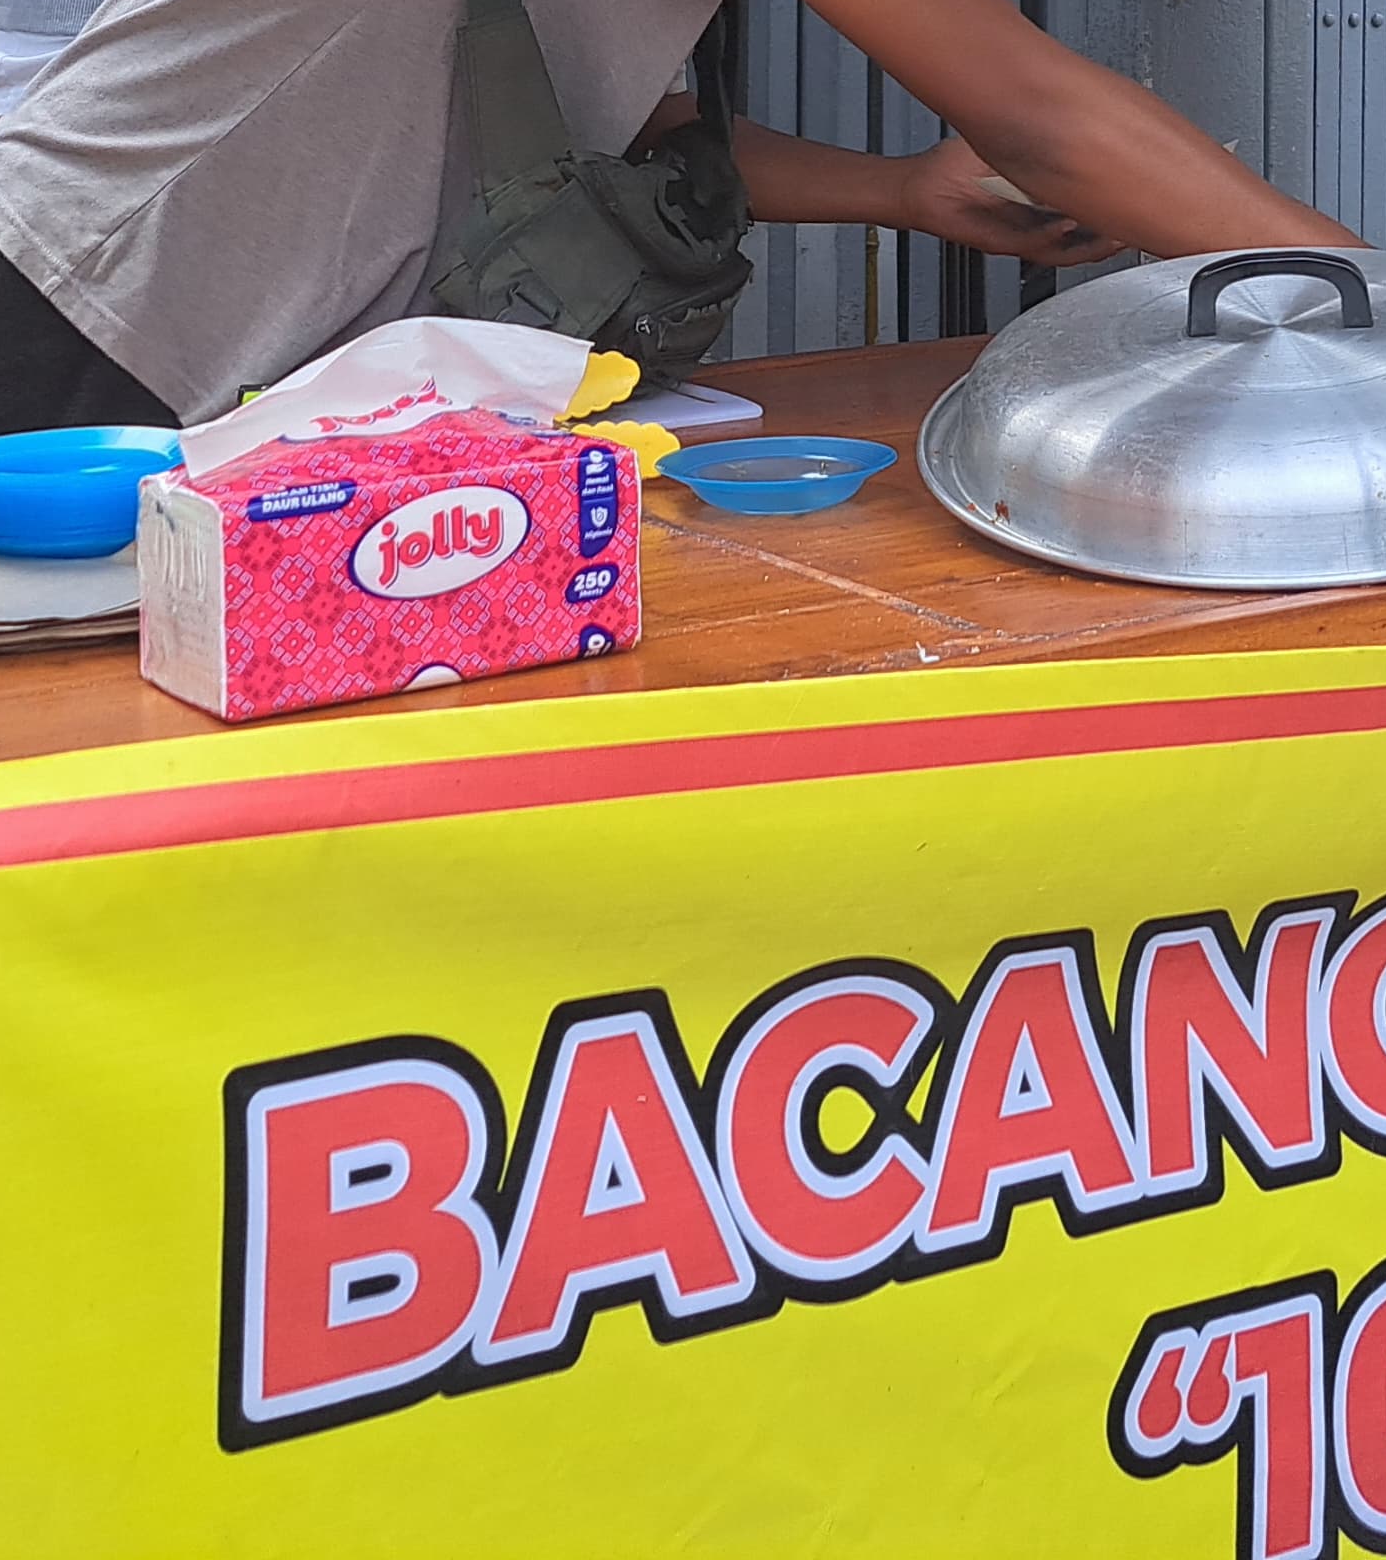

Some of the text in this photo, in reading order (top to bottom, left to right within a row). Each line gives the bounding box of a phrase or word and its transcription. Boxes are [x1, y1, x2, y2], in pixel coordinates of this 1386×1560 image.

[262, 490, 346, 514] DAUR ULANG
[378, 505, 504, 589] jolly
[574, 569, 612, 592] 250
